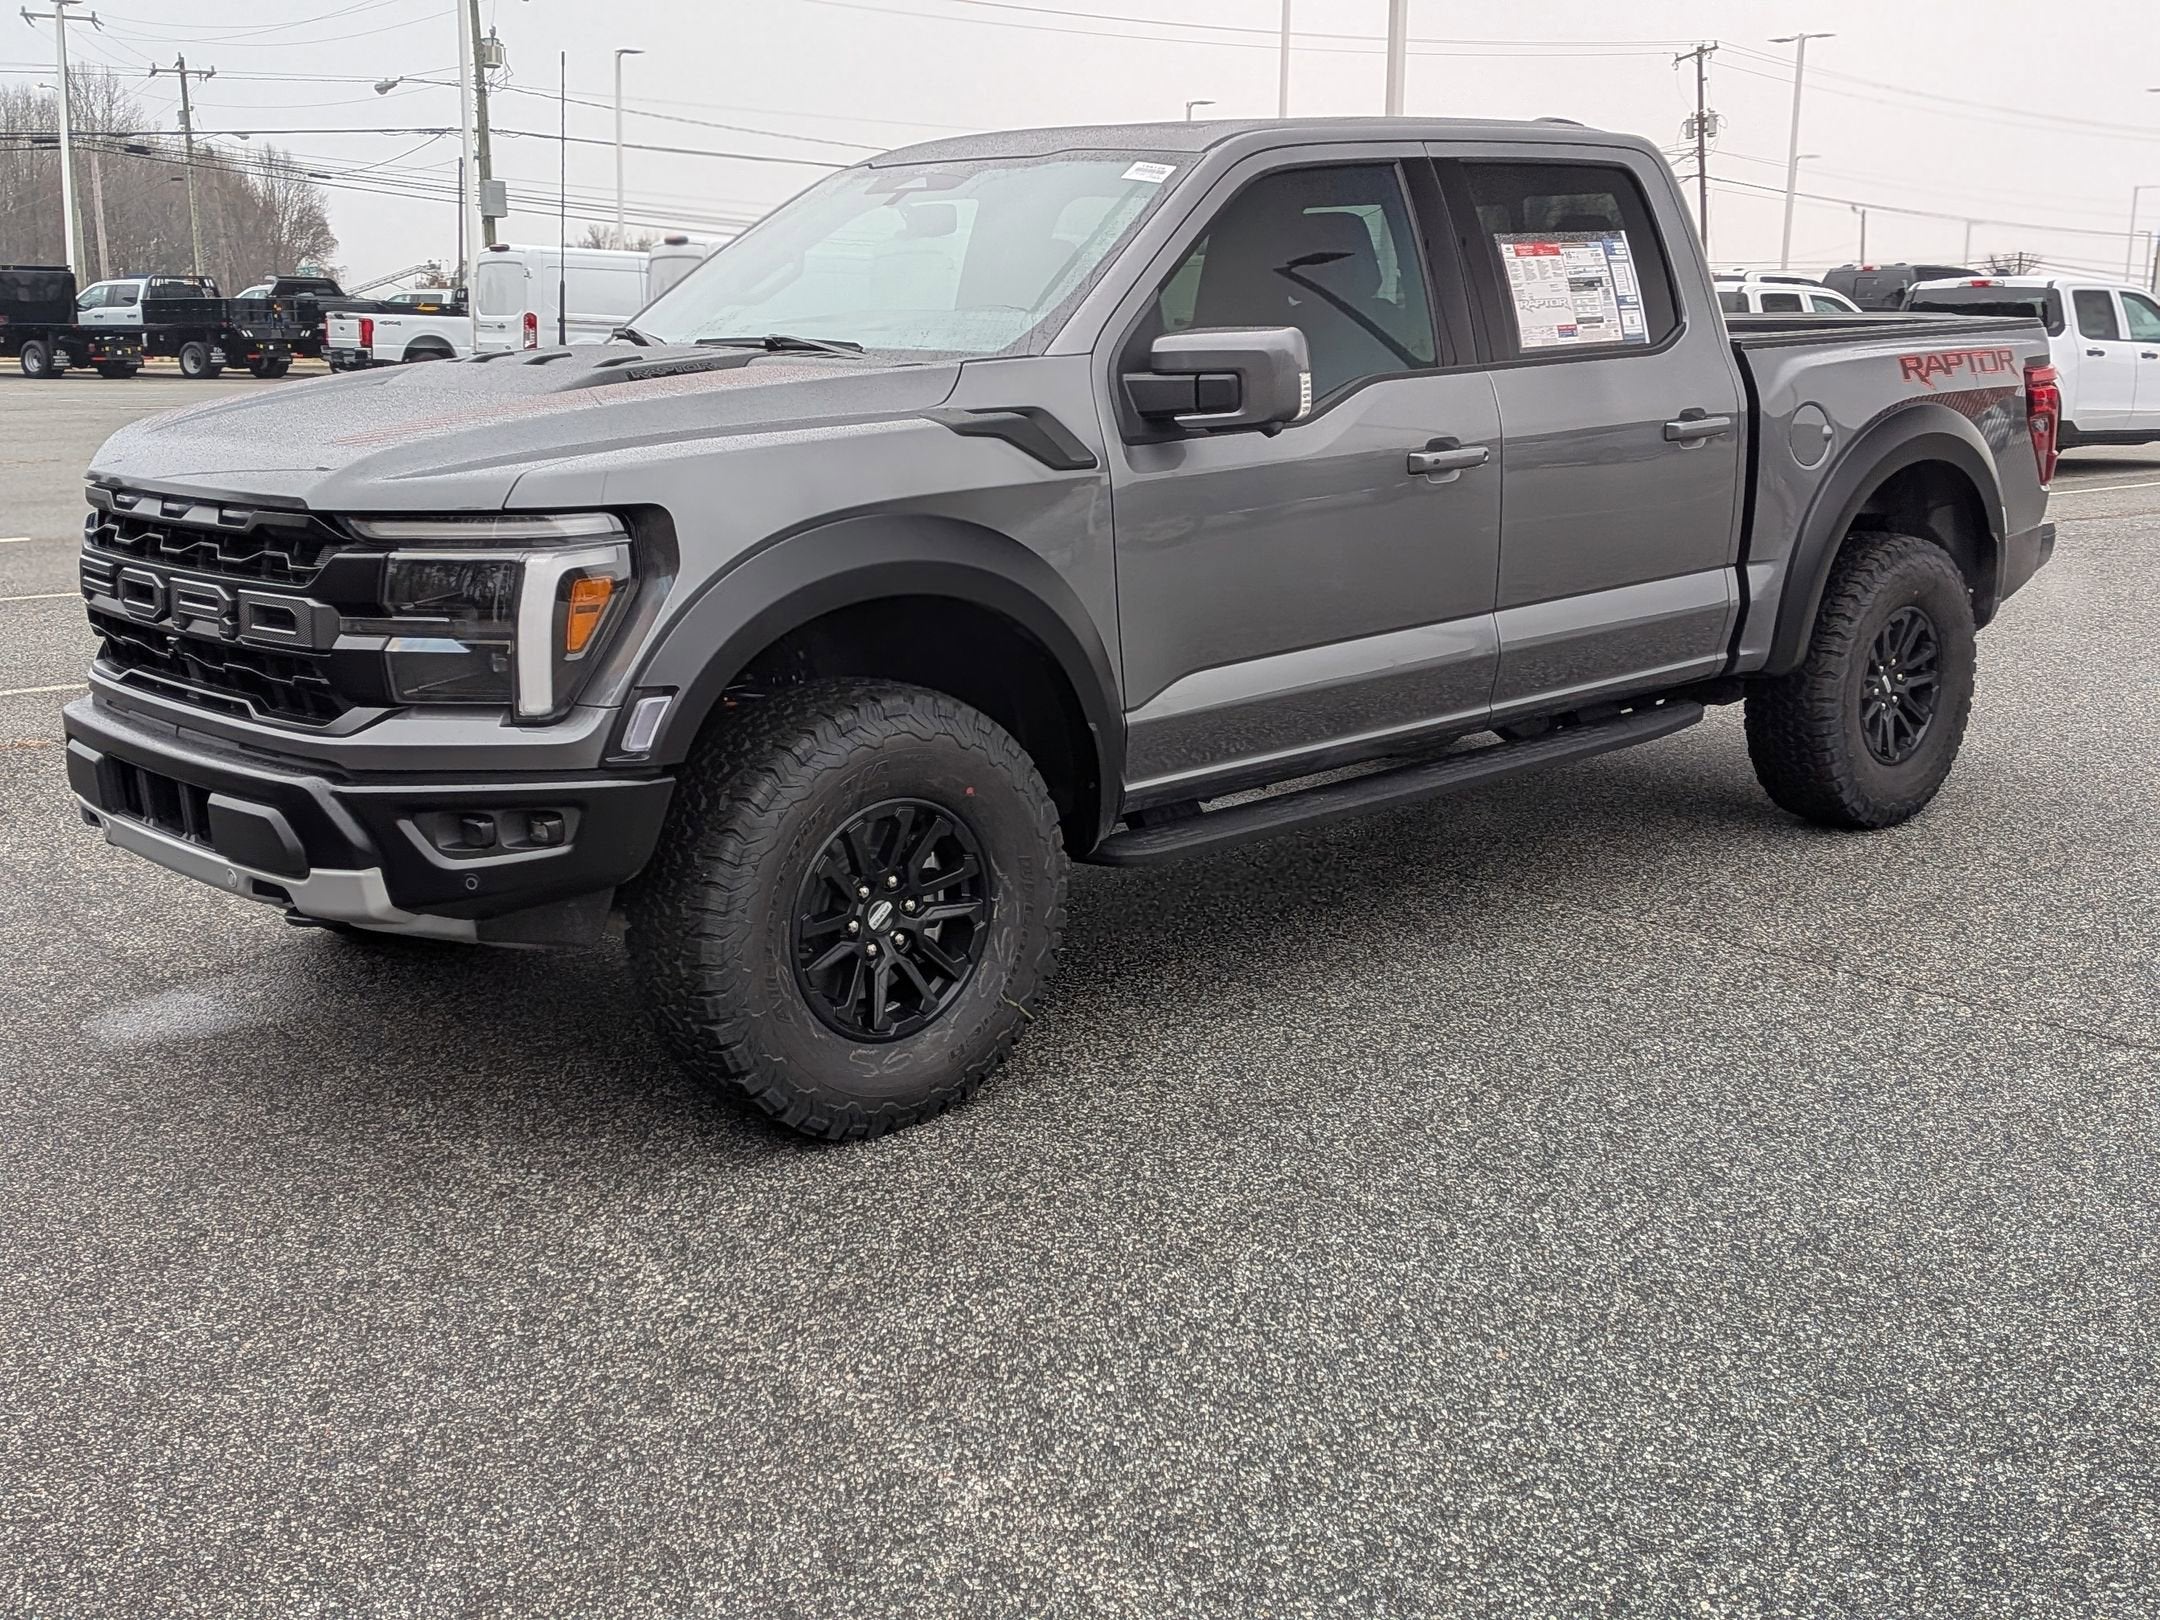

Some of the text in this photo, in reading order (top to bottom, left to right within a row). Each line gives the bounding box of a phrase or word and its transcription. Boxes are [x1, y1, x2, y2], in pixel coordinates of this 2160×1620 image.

[1520, 297, 1571, 312] RAPTOR
[628, 362, 714, 380] RAPTOR
[1899, 347, 2021, 390] RAPTOR
[80, 554, 336, 655] FORD
